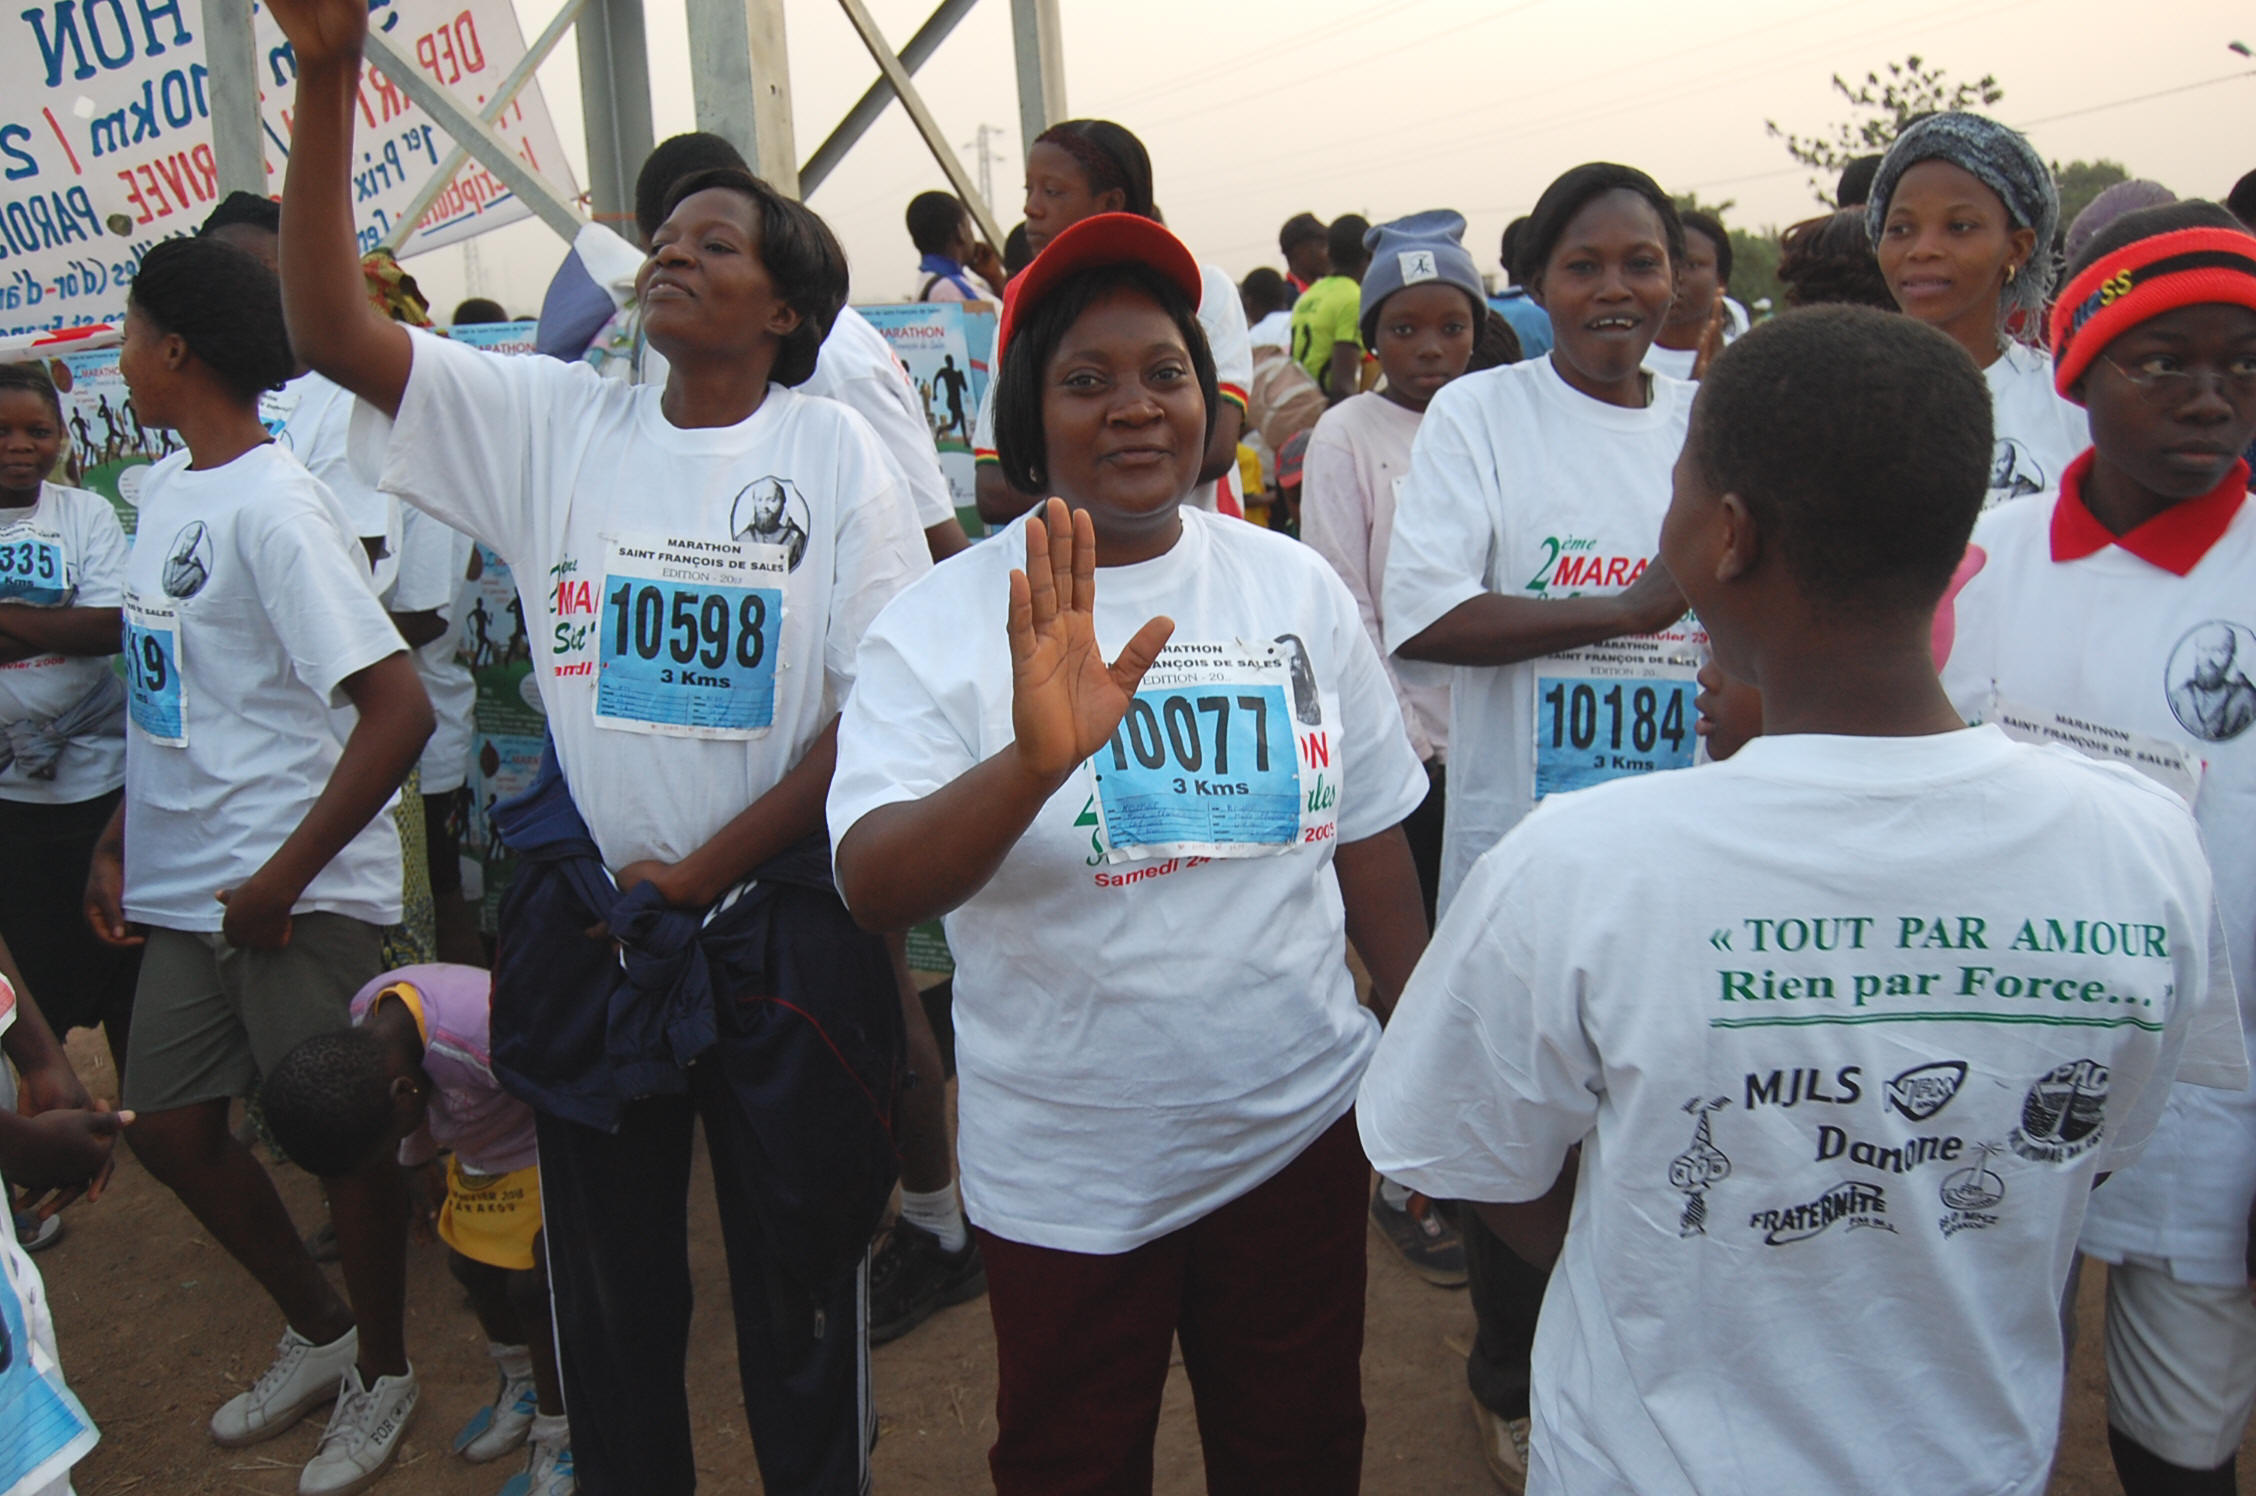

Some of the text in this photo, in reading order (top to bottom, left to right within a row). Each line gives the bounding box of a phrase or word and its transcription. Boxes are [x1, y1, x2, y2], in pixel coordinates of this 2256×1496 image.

[618, 547, 784, 573] SAINT FRANÇOIS DE SALES
[668, 538, 742, 555] MARATHON
[662, 567, 710, 581] EDITION
[1552, 556, 1648, 588] MARA
[610, 582, 767, 670] 10598
[1161, 645, 1223, 654] RATHON
[1649, 656, 1663, 664] DE
[660, 669, 732, 689] 3 Kms
[1143, 672, 1198, 686] EDITION
[1152, 659, 1209, 671] ANÇOIS
[1214, 659, 1233, 667] DE
[1545, 682, 1686, 754] 10184
[2055, 713, 2130, 742] MARATHON
[1110, 695, 1270, 775] 10077
[2003, 715, 2181, 770] SAINT FRANÇOIS DE SALES
[1593, 755, 1655, 772] 3 Kms
[1173, 778, 1250, 796] 3 Kms
[1094, 859, 1179, 888] Samedi
[1743, 917, 1874, 953] TOUT
[1898, 916, 1989, 951] PAR
[2008, 918, 2170, 958] AMOUR
[1718, 969, 1836, 1003] Rien
[1852, 972, 1941, 1007] par
[1744, 1065, 1863, 1111] MJLS
[1814, 1124, 1964, 1174] Danone
